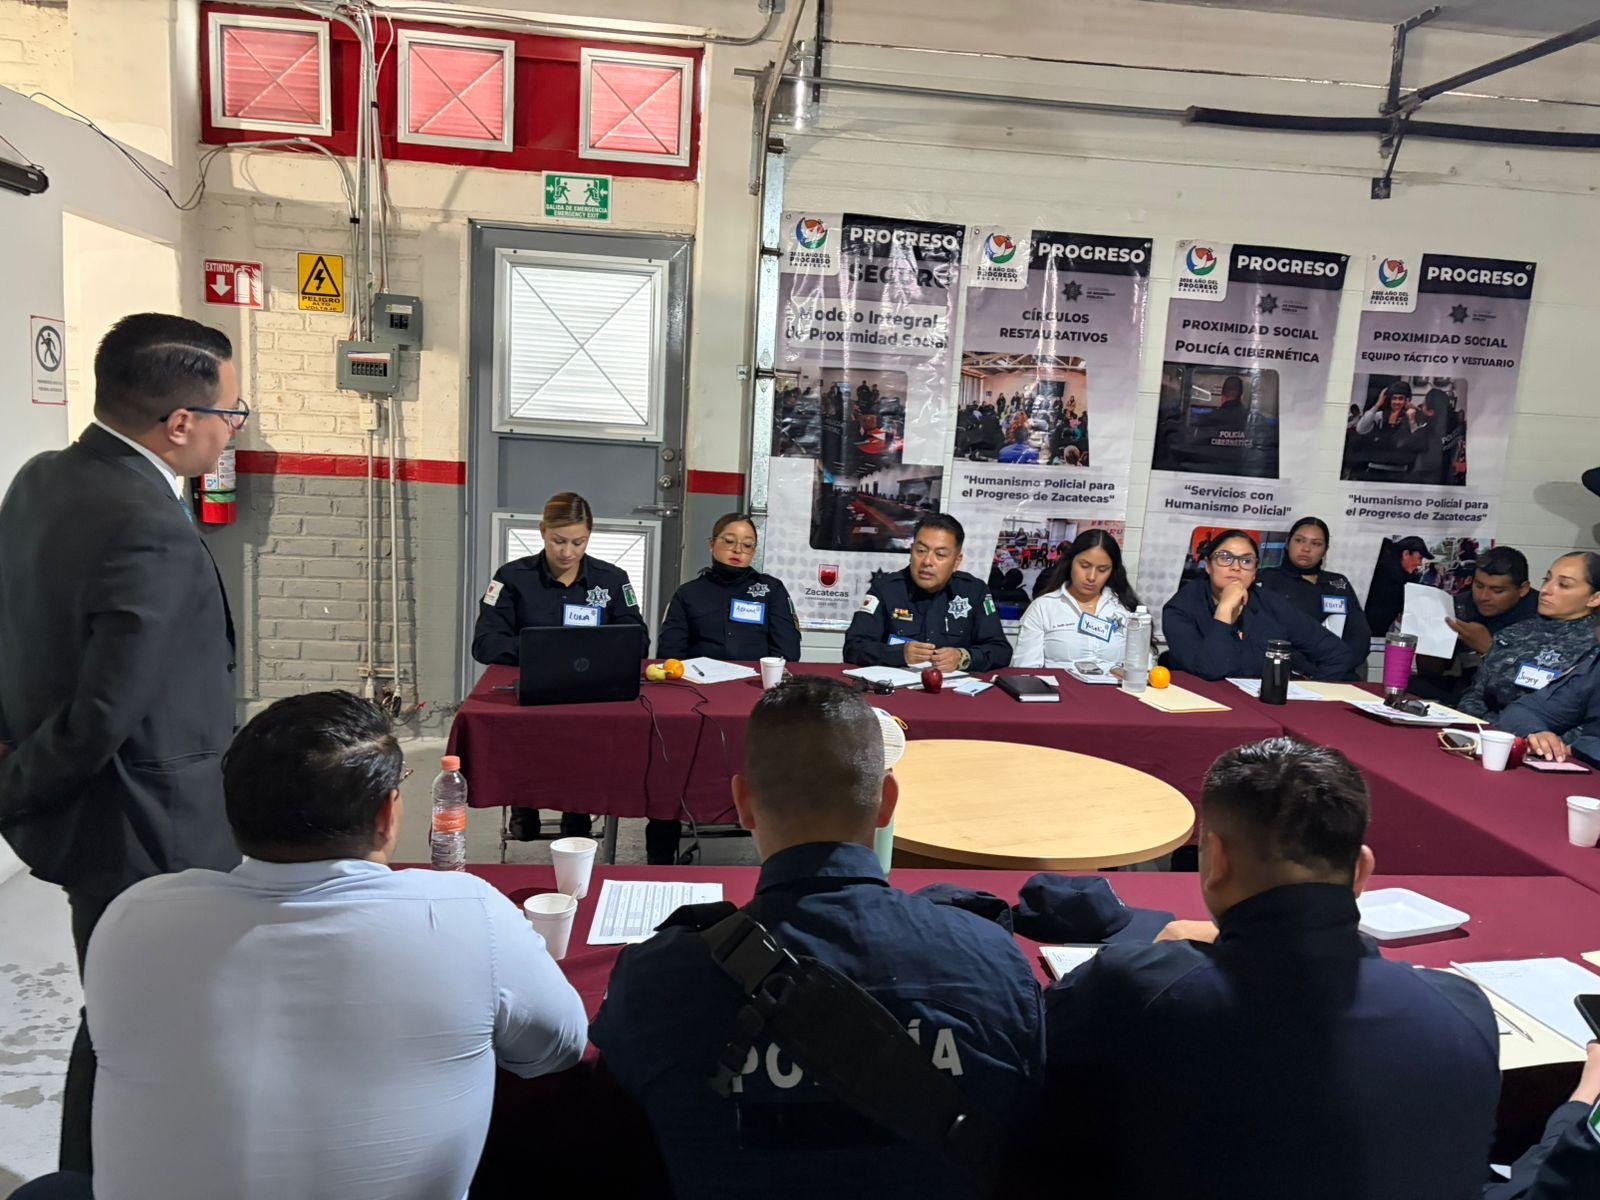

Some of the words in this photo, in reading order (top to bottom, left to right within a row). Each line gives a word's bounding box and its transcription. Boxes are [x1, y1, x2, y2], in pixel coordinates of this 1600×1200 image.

[850, 227, 957, 249] PROGRESO
[1038, 242, 1146, 264] PROGRESO
[205, 262, 234, 273] EXTINTOR
[1237, 255, 1339, 277] PROGRESO
[1427, 266, 1529, 287] PROGRESO
[1178, 282, 1218, 290] PROGRESO
[1022, 307, 1090, 324] CÍRCULOS
[999, 327, 1109, 343] RESTAURATIVOS
[1182, 319, 1269, 336] PROXIMIDAD
[1273, 326, 1319, 340] SOCIAL
[1373, 331, 1461, 345] PROXIMIDAD
[1464, 335, 1509, 349] SOCIAL
[1175, 340, 1230, 356] POLICÍA
[1233, 346, 1320, 363] CIBERNÉTICA
[1361, 351, 1401, 362] EQUIPO
[1403, 349, 1448, 364] TÁCTICO
[1452, 355, 1459, 364] Y
[1461, 356, 1515, 368] VESTUARIO
[963, 474, 1041, 487] "Humanismo
[1044, 478, 1087, 490] Policial
[1088, 481, 1115, 492] para
[961, 488, 973, 498] el
[975, 489, 1030, 502] Progreso
[1033, 491, 1049, 501] de
[1051, 492, 1115, 504] Zacatecas"
[1250, 491, 1274, 501] con
[1348, 494, 1422, 507] "Humanismo
[1425, 497, 1462, 509] Policial
[1464, 501, 1489, 511] para
[1165, 498, 1239, 513] Humanismo
[1242, 504, 1292, 517] Policial"
[1346, 508, 1356, 516] el
[1358, 508, 1411, 520] Progreso
[1413, 510, 1430, 520] de
[1432, 511, 1488, 522] Zacatecas"
[805, 588, 849, 597] Zacatecas
